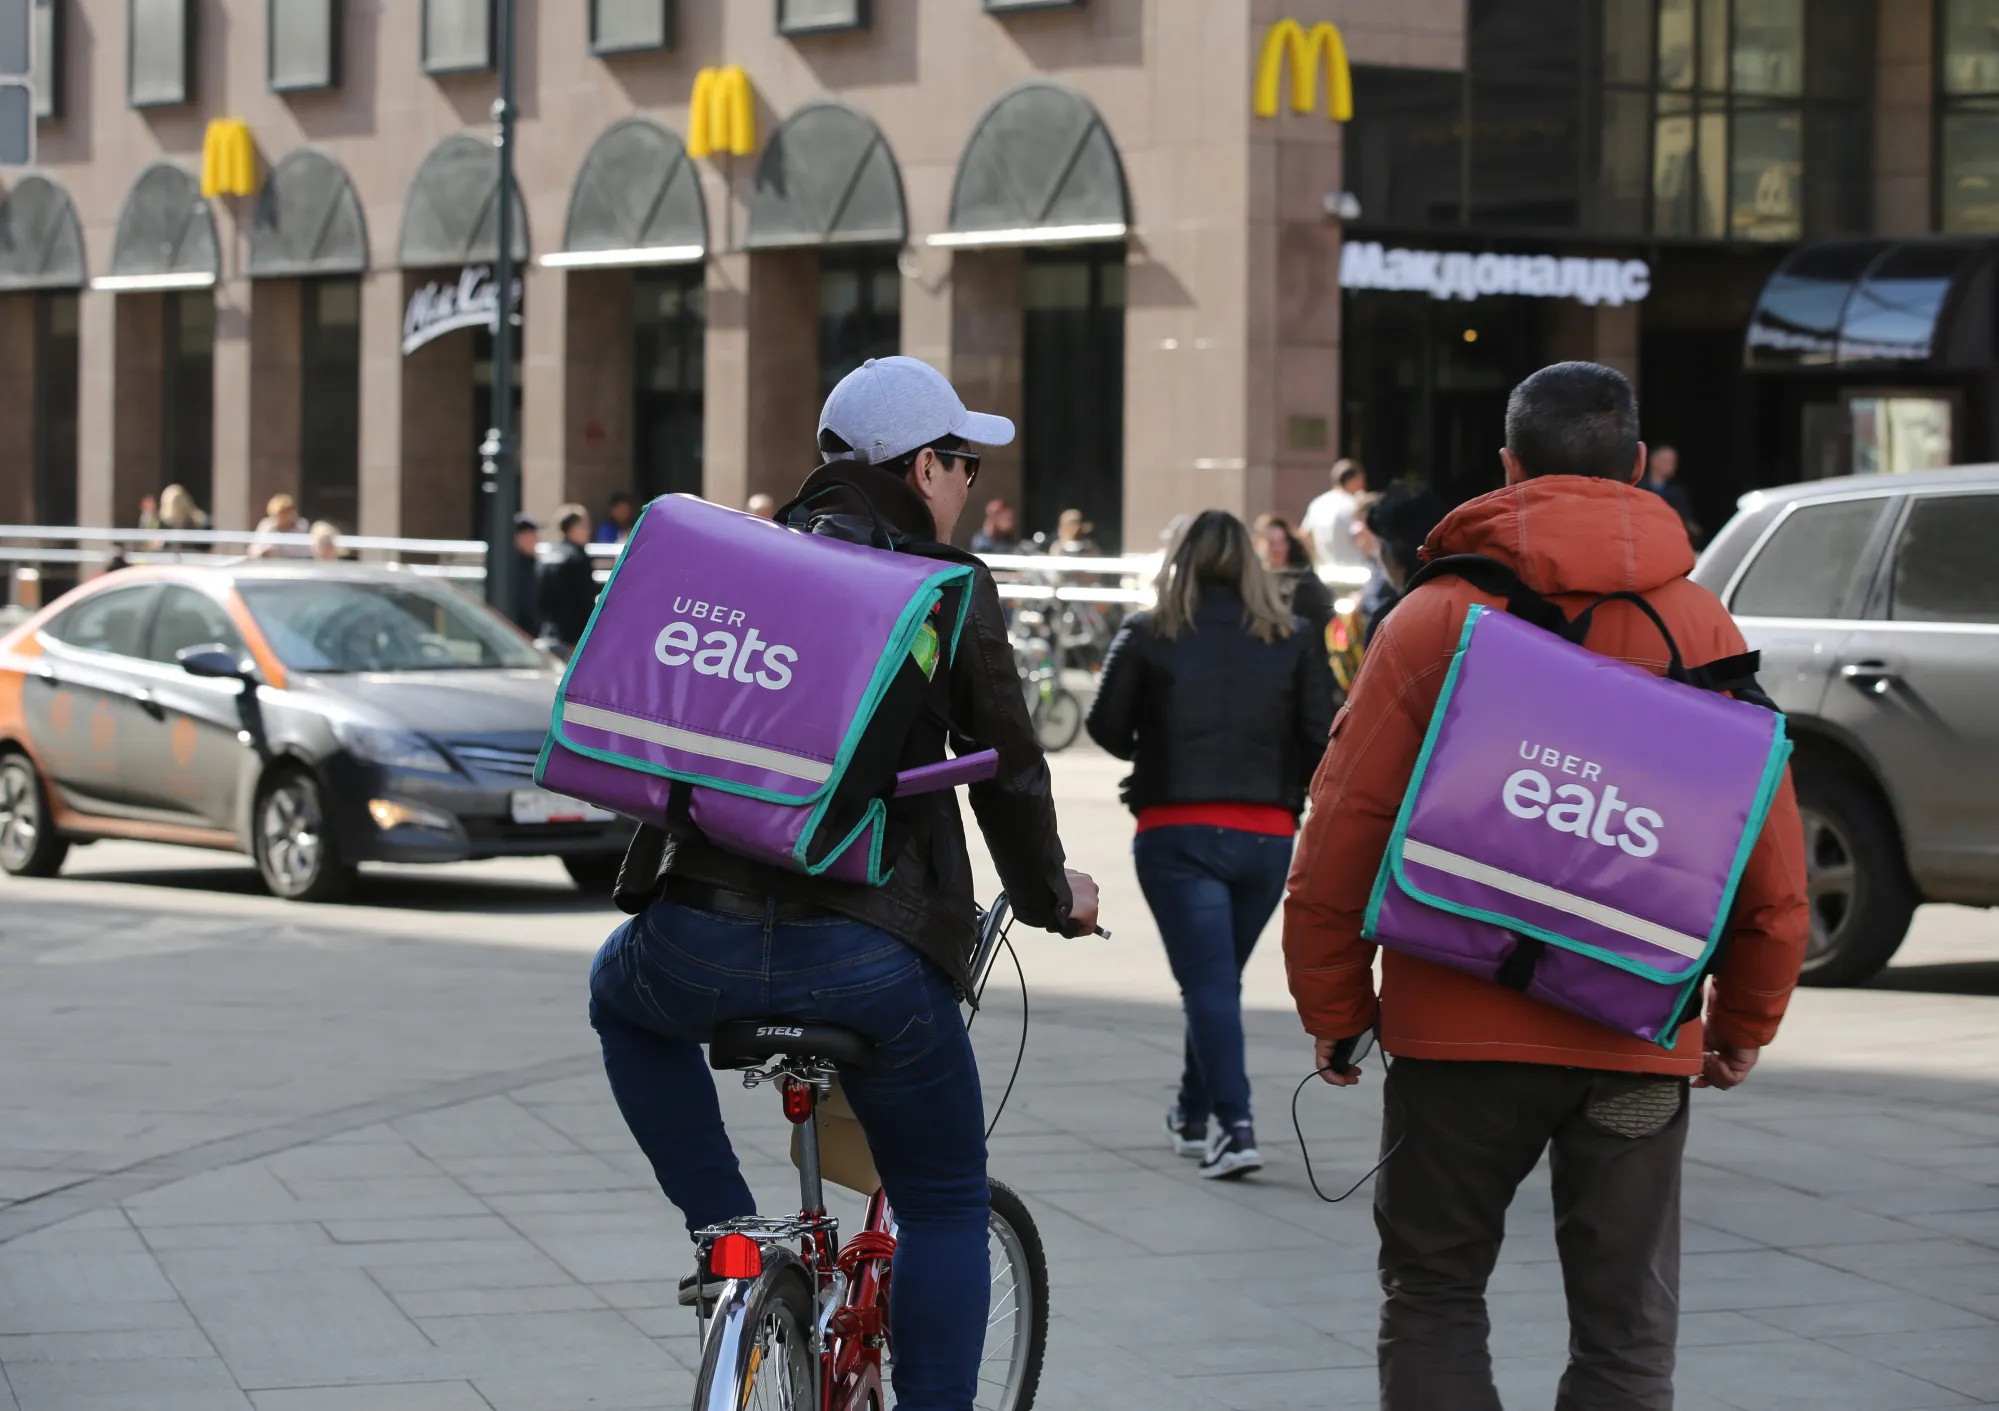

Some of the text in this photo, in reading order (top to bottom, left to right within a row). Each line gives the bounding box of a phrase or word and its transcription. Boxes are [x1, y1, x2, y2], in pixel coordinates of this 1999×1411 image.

[1340, 241, 1650, 306] Макдоналдс
[672, 596, 746, 627] UBER
[655, 621, 798, 690] eats
[1519, 740, 1602, 782] UBER
[1502, 769, 1664, 858] eats
[756, 1026, 804, 1037] STELS
